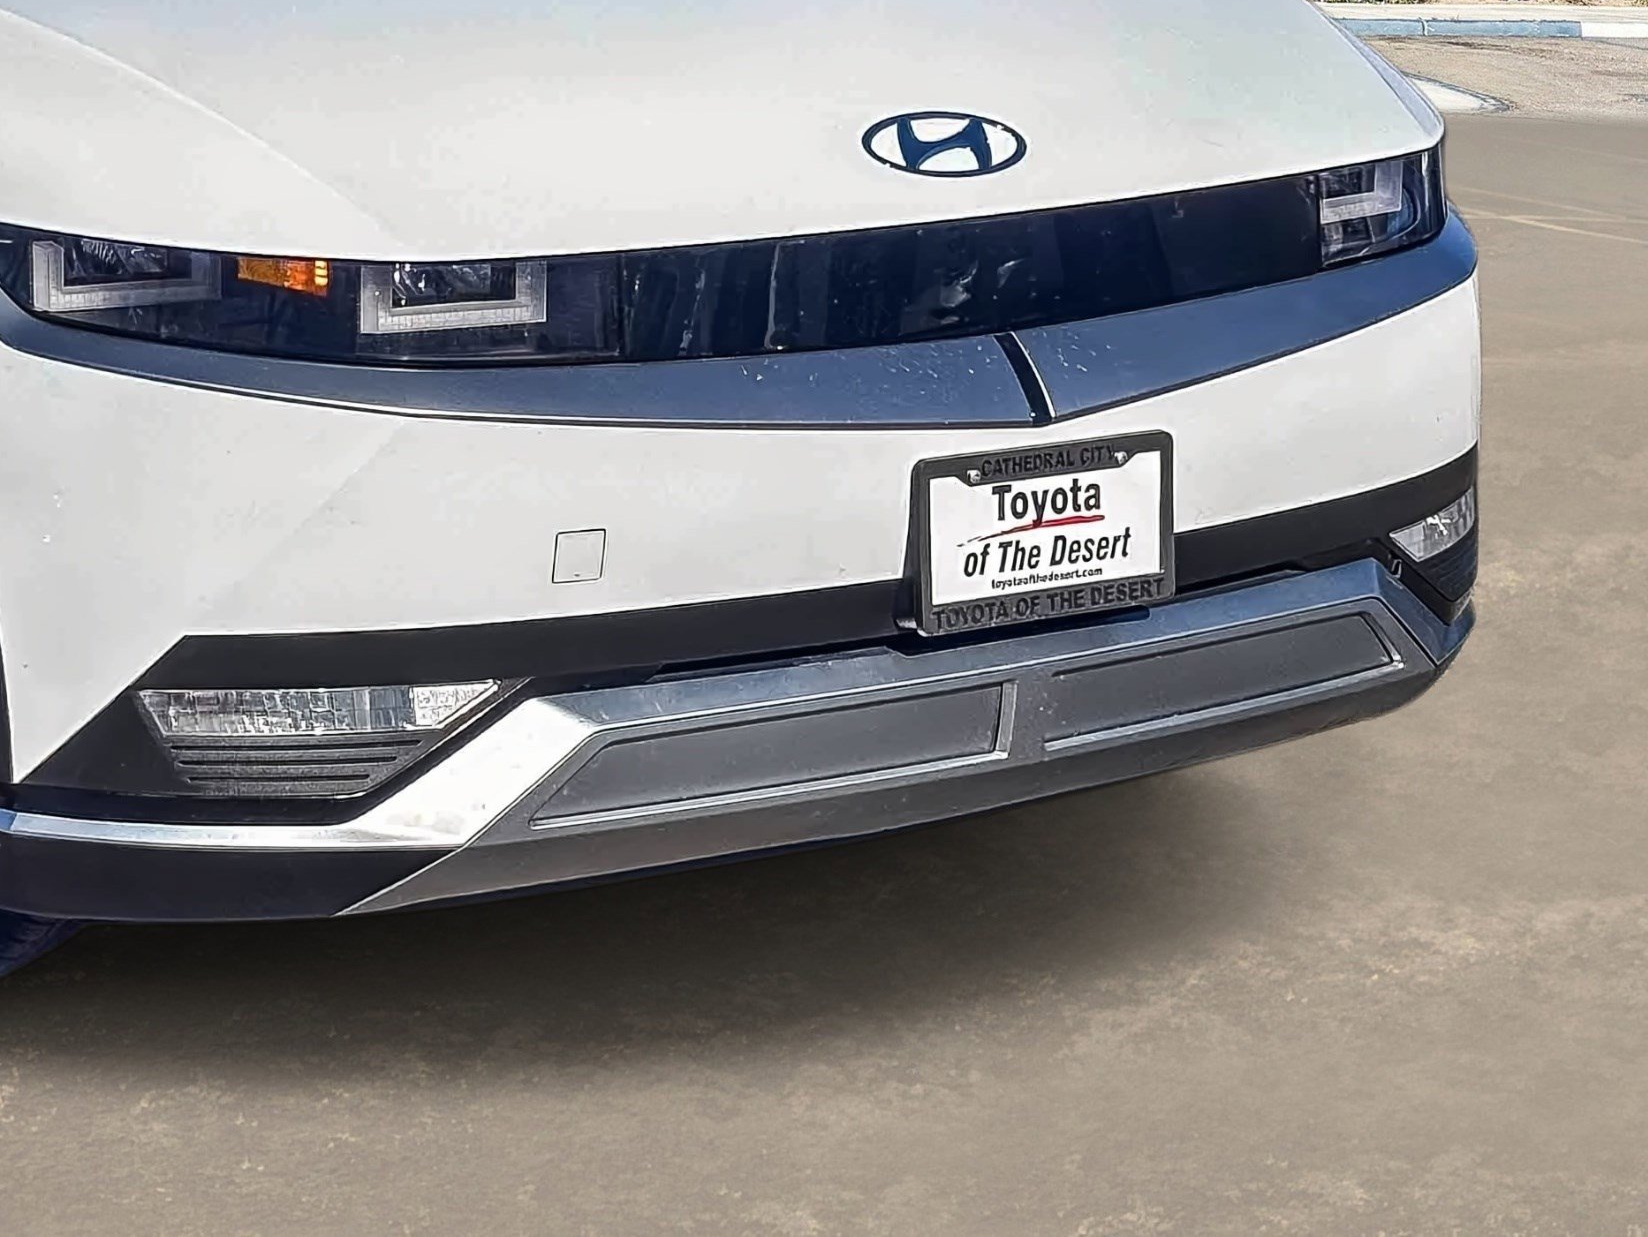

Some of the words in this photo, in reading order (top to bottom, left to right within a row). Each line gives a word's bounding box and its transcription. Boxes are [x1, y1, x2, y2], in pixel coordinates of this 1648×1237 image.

[981, 449, 1075, 476] CATHEDRAL
[1078, 444, 1116, 467] CITY
[992, 478, 1101, 527] Toyota
[963, 540, 990, 577] of
[997, 536, 1041, 573] The
[1049, 527, 1131, 567] Desert
[932, 601, 1008, 631] TOYOTA
[1011, 596, 1040, 620] OF
[1047, 587, 1088, 611] THE
[1091, 578, 1165, 606] DESERT
